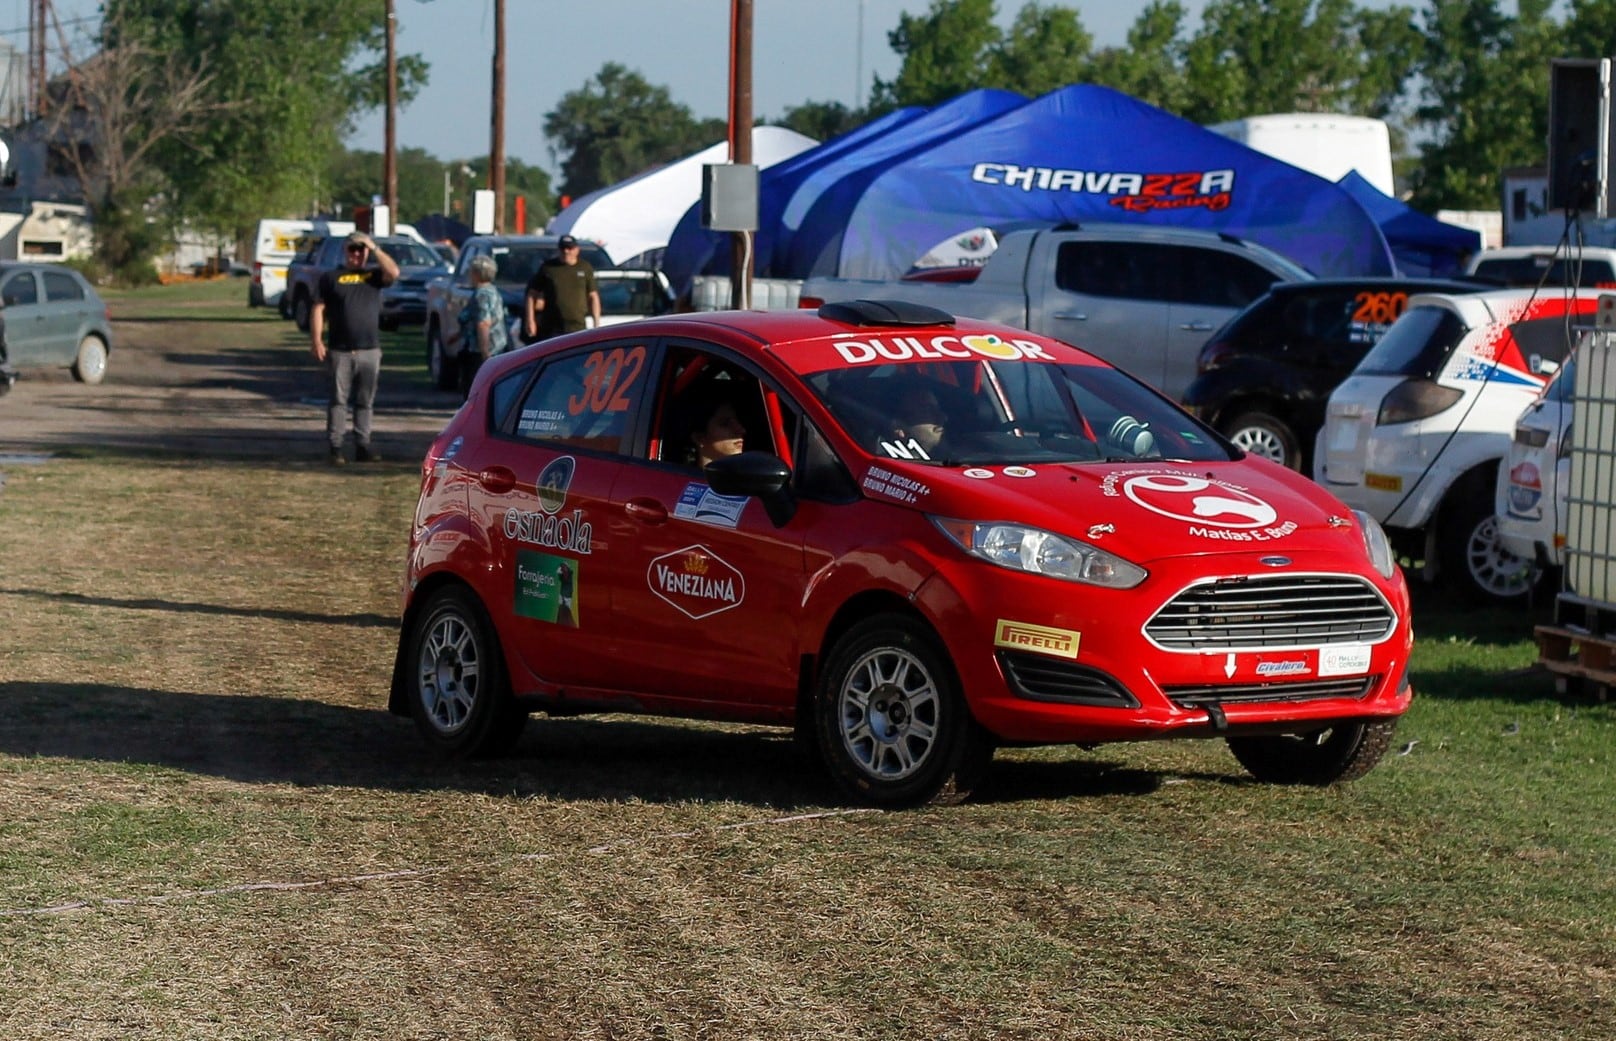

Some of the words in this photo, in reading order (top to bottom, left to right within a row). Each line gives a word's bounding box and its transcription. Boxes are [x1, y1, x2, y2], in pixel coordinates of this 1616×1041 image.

[1109, 193, 1231, 213] Racing
[1352, 291, 1409, 325] 260
[833, 335, 1056, 363] DULCOR
[568, 346, 646, 416] 302
[881, 438, 930, 460] N1
[863, 477, 886, 492] BRUNO
[885, 485, 907, 500] MARIO
[868, 466, 891, 481] BRUNO
[890, 474, 920, 491] NICOLAS
[504, 508, 592, 554] esnaola
[657, 563, 736, 602] VENEZIANA
[1002, 625, 1072, 651] PIRELLI
